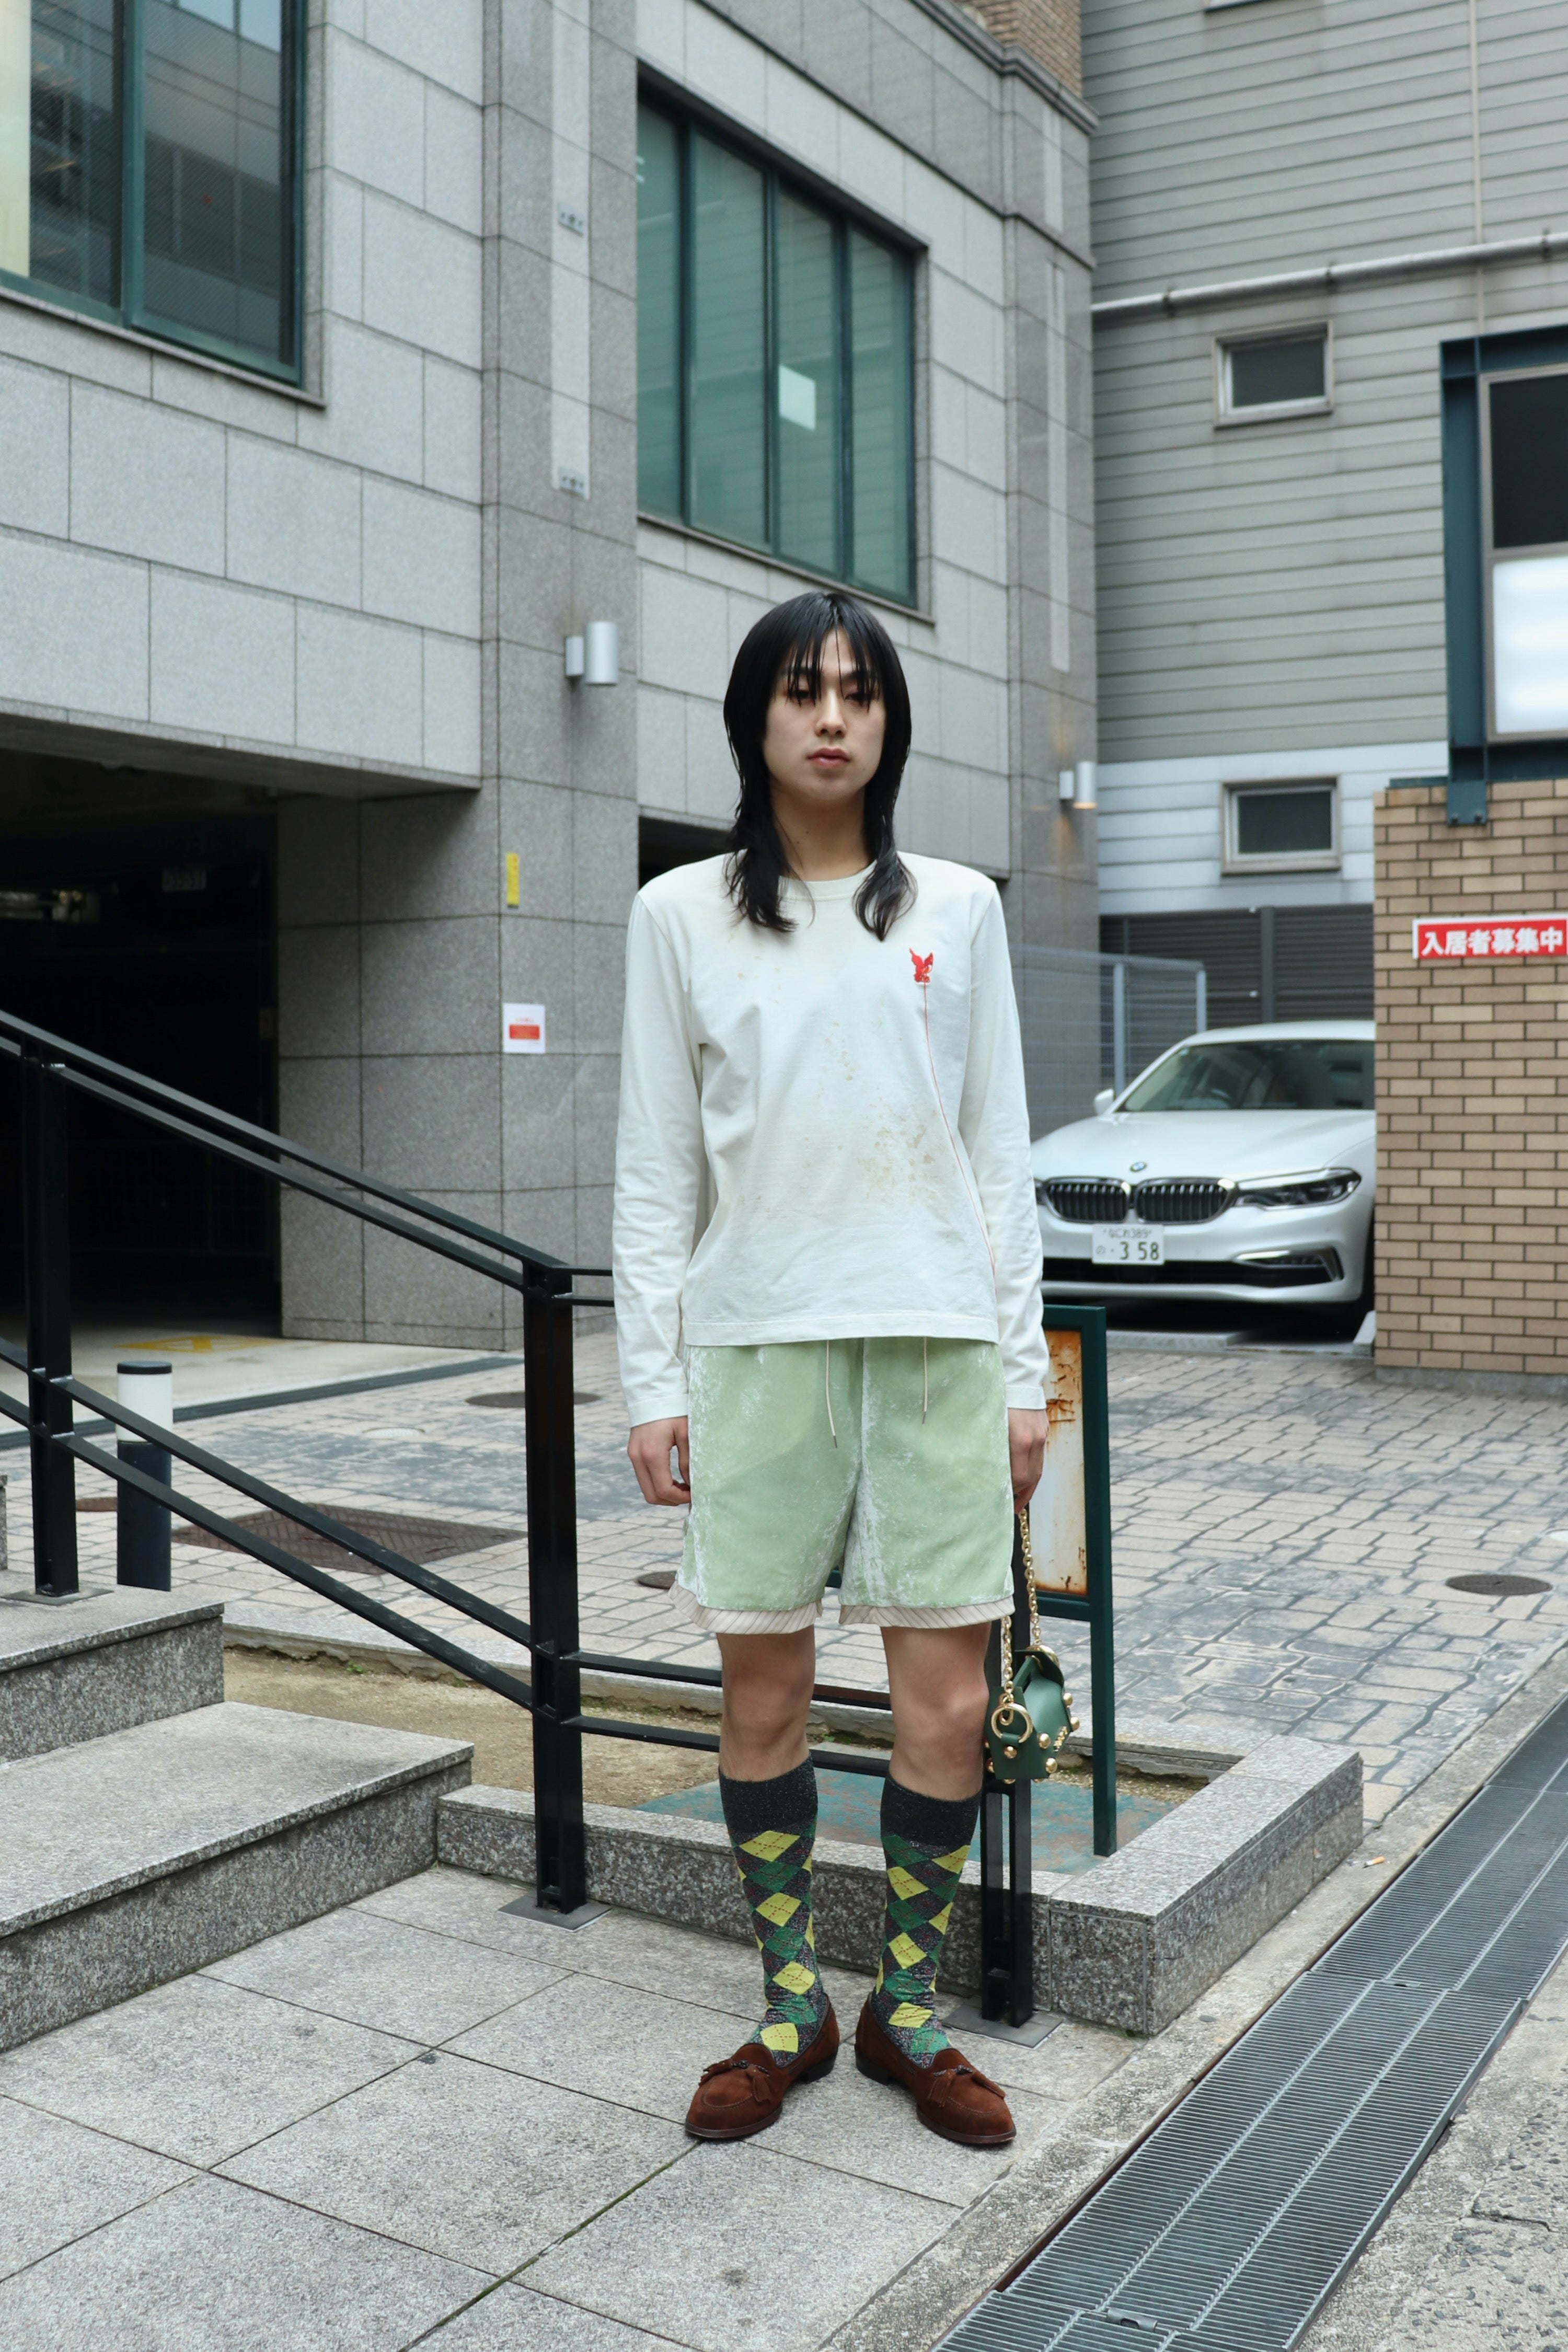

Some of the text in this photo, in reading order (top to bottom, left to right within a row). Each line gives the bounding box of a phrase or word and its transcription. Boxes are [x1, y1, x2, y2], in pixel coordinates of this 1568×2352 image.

[1422, 927, 1562, 955] 入居者募集中
